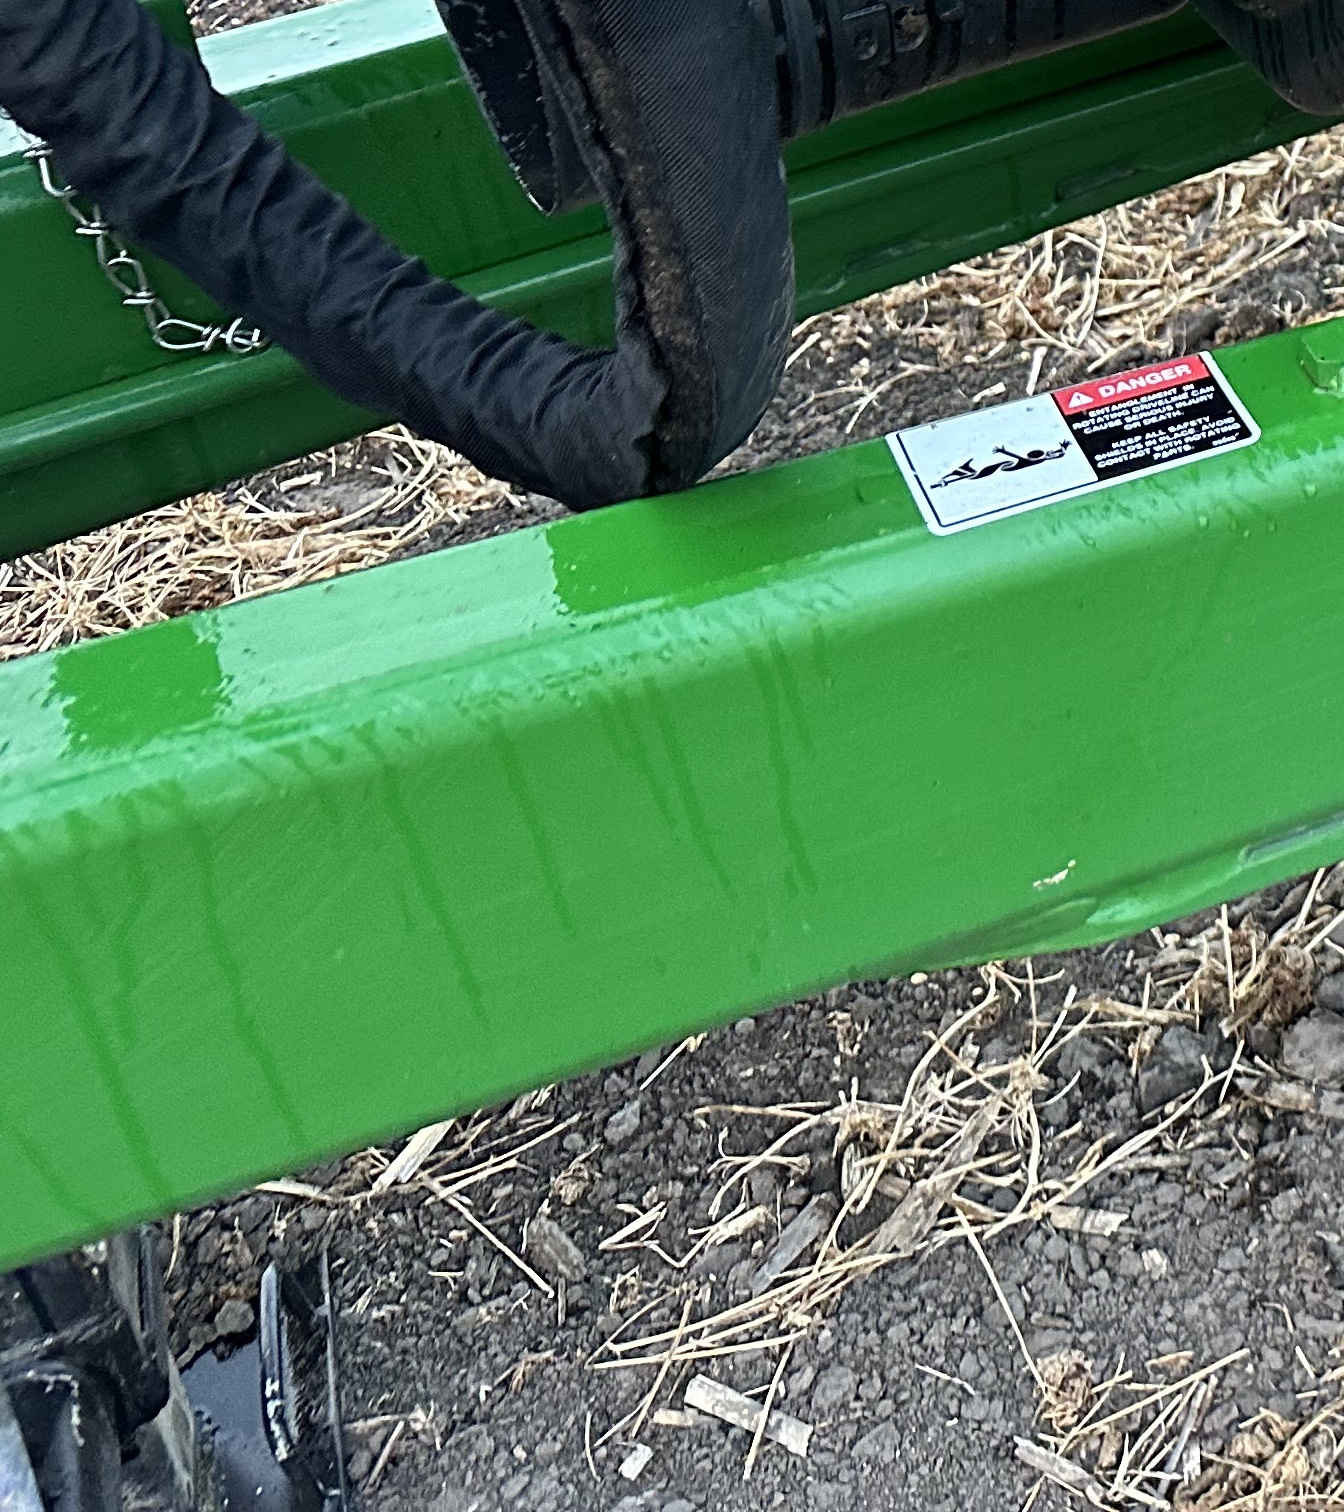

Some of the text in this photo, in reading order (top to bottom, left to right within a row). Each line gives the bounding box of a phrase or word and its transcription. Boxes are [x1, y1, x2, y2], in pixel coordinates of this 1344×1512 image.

[1099, 364, 1191, 398] DANGER
[1072, 386, 1215, 430] ROTATING DRIVELINE CAN
[1083, 393, 1214, 434] CAUSE SERIOUS INJURY
[1089, 384, 1195, 418] ENTANGLEMENT IN
[1094, 443, 1143, 461] SHIELDS
[1144, 438, 1158, 446] IN
[1202, 417, 1235, 431] AVOID
[1112, 416, 1210, 449] KEEP ALL SAFETY
[1123, 421, 1141, 430] OR
[1097, 449, 1151, 468] CONTACT
[1152, 439, 1182, 451] WITH
[1184, 423, 1241, 443] ROTATING
